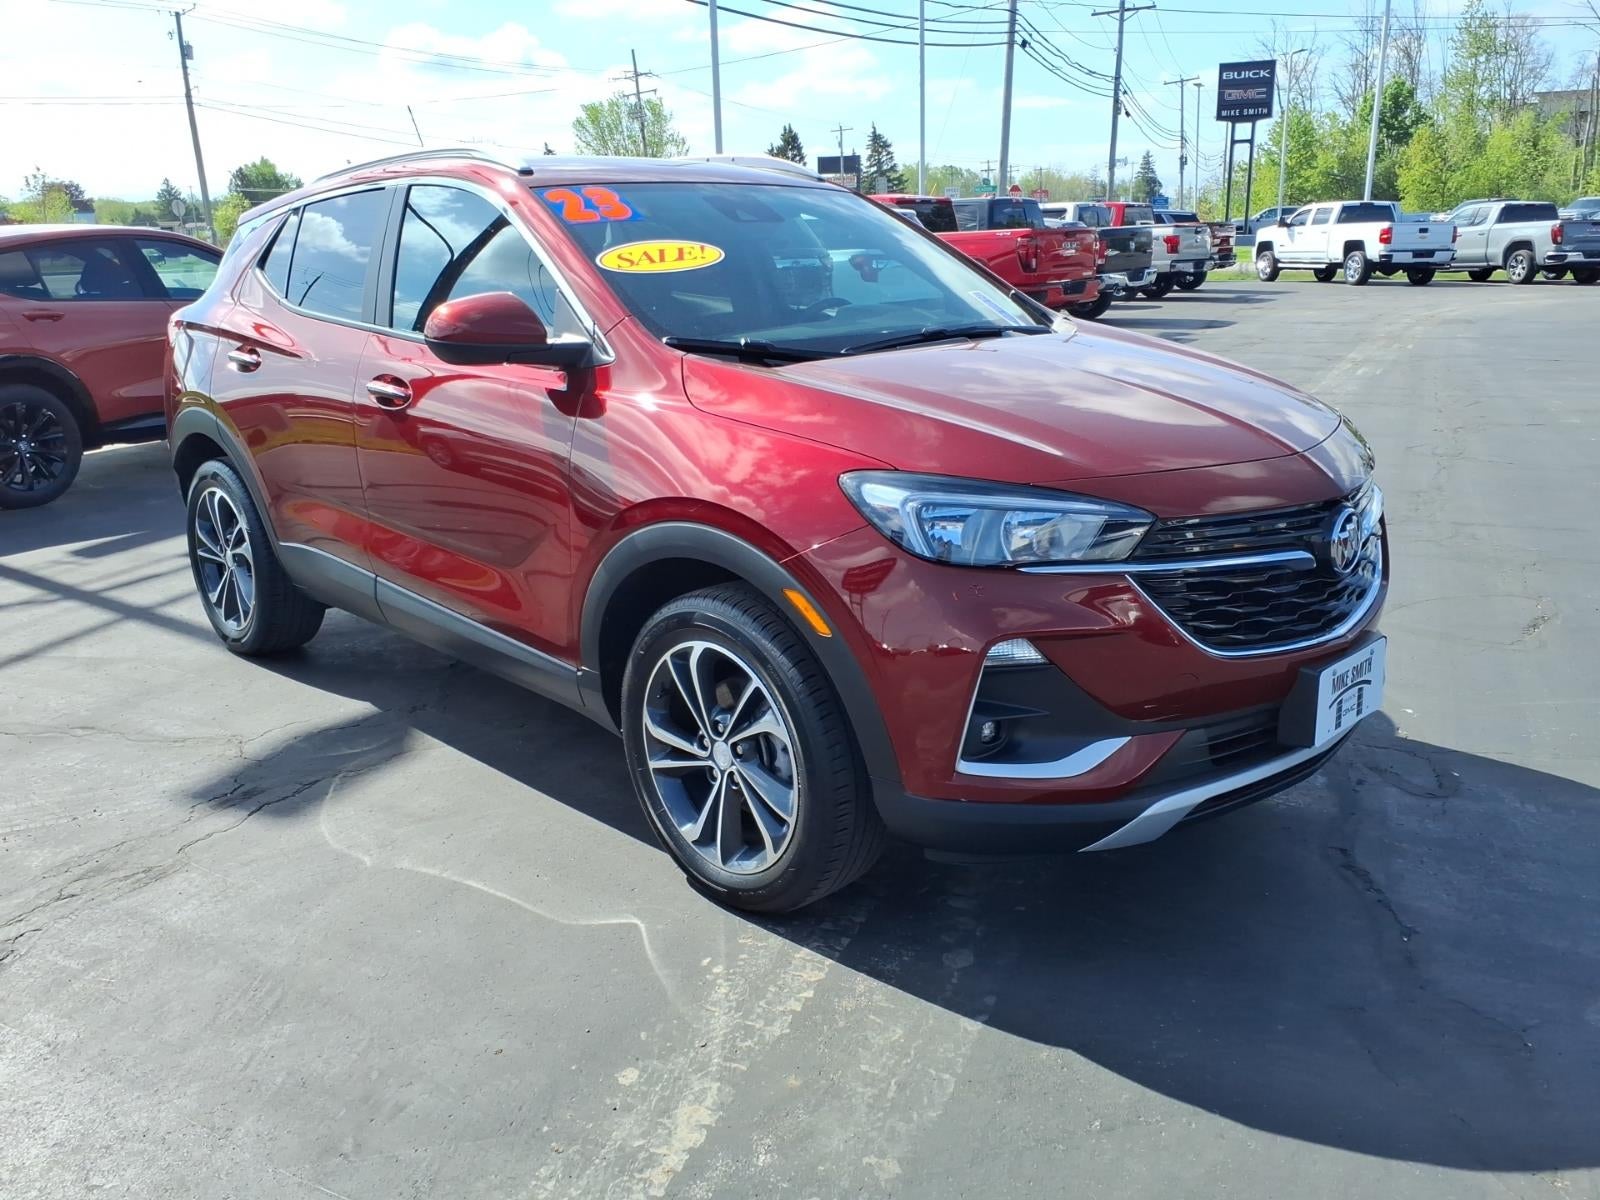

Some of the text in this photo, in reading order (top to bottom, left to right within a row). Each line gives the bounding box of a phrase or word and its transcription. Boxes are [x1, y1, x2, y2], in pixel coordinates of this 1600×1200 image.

[1222, 69, 1271, 80] BUICK
[1224, 88, 1267, 100] GMC
[1221, 109, 1240, 117] MIKE
[543, 187, 633, 223] 23
[617, 245, 707, 270] SALE!
[1332, 657, 1373, 695] MIKE SMITH
